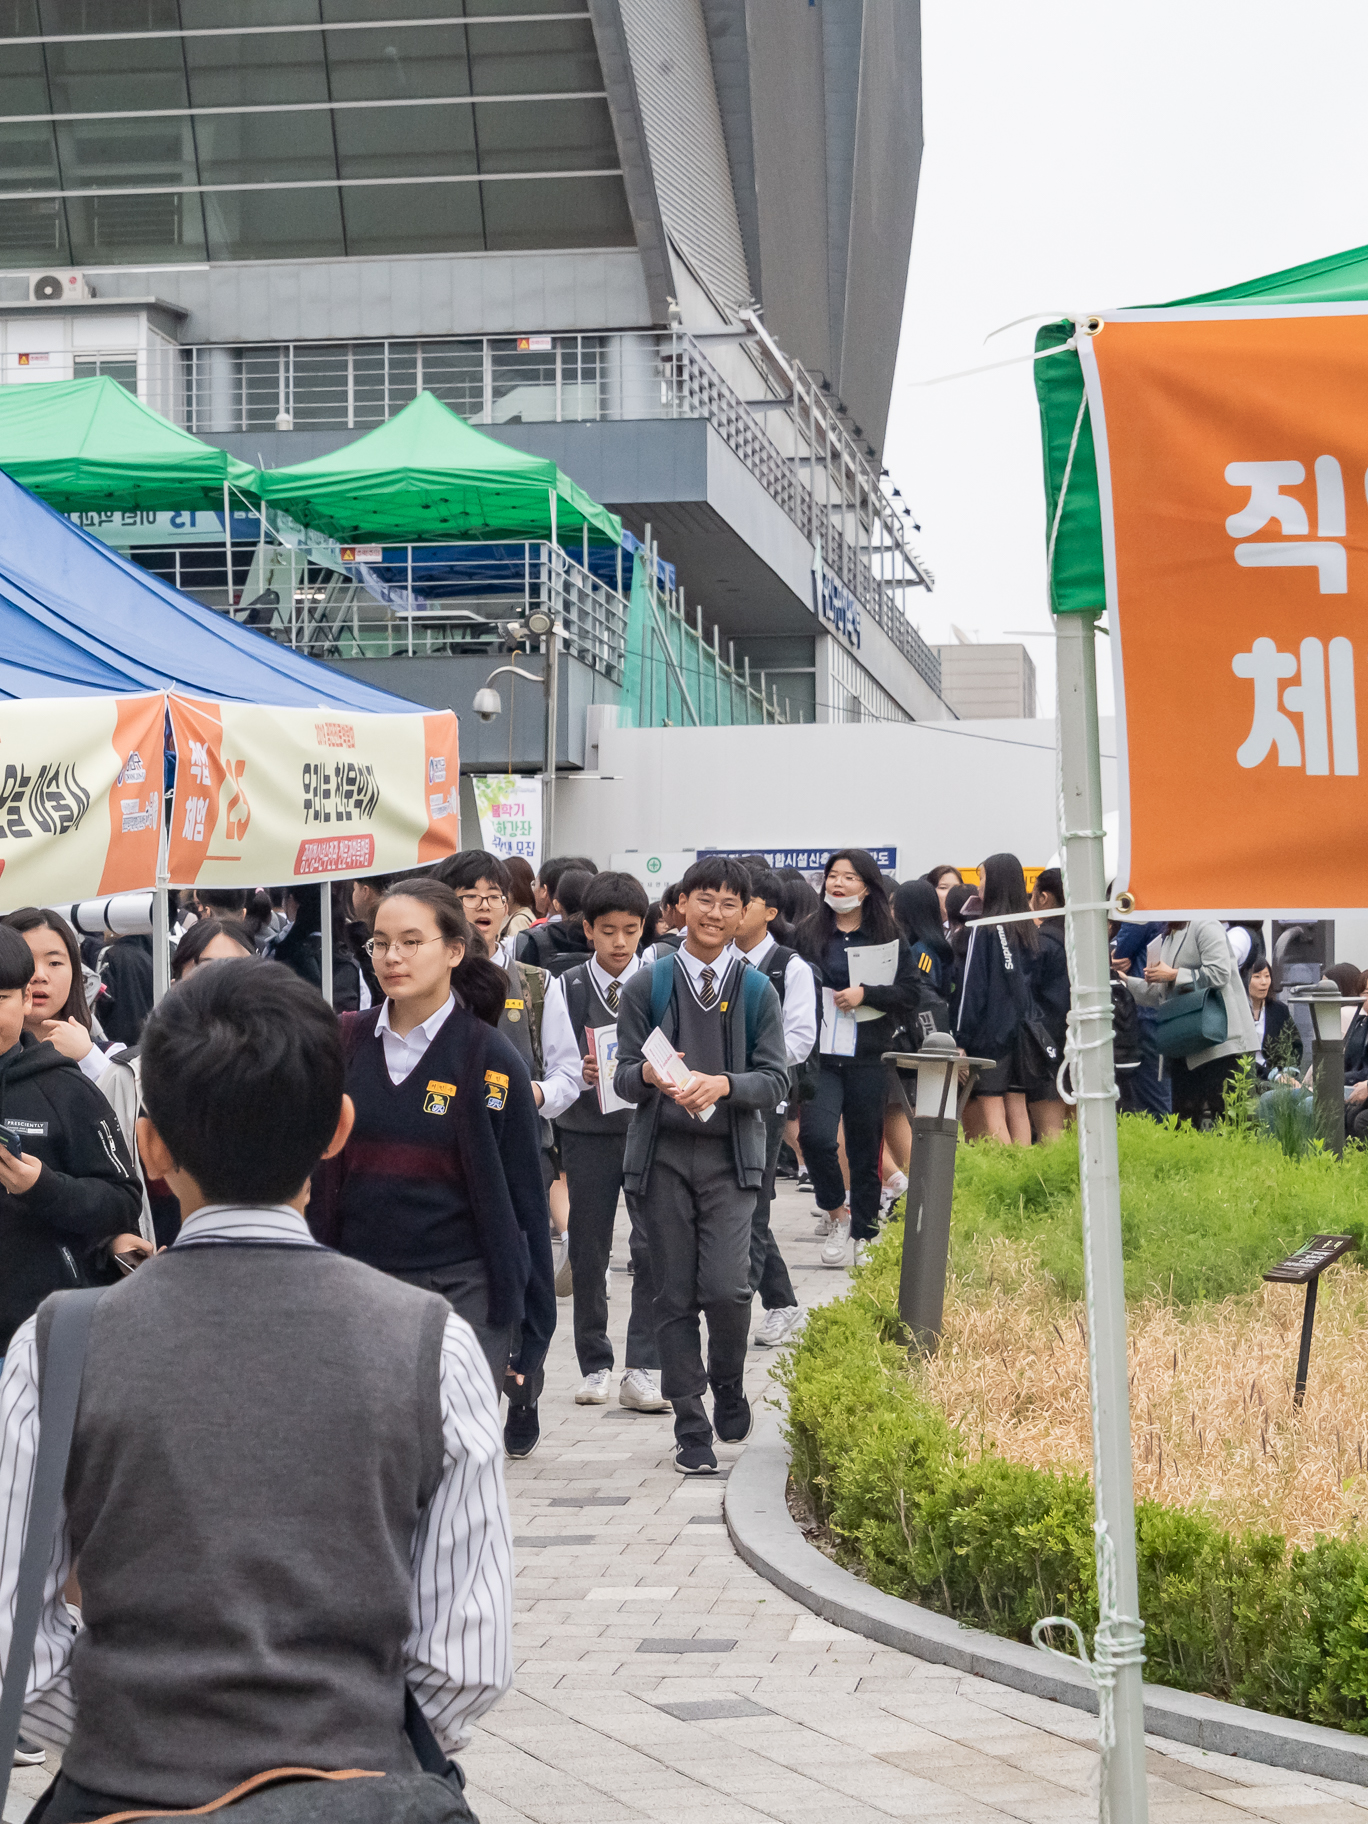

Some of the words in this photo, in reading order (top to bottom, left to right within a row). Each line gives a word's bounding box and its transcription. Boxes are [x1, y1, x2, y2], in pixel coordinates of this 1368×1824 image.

[1224, 454, 1368, 594] 직
[188, 739, 211, 786] 직업
[29, 761, 91, 836] 마술사
[225, 758, 251, 842] 25
[303, 761, 331, 825] 우리는
[334, 761, 381, 821] 천문학자
[182, 795, 209, 842] 체험
[492, 820, 533, 838] 화강좌
[516, 841, 536, 857] 모집
[996, 924, 1014, 970] Supreme
[7, 1120, 44, 1128] PRESCIENTLY
